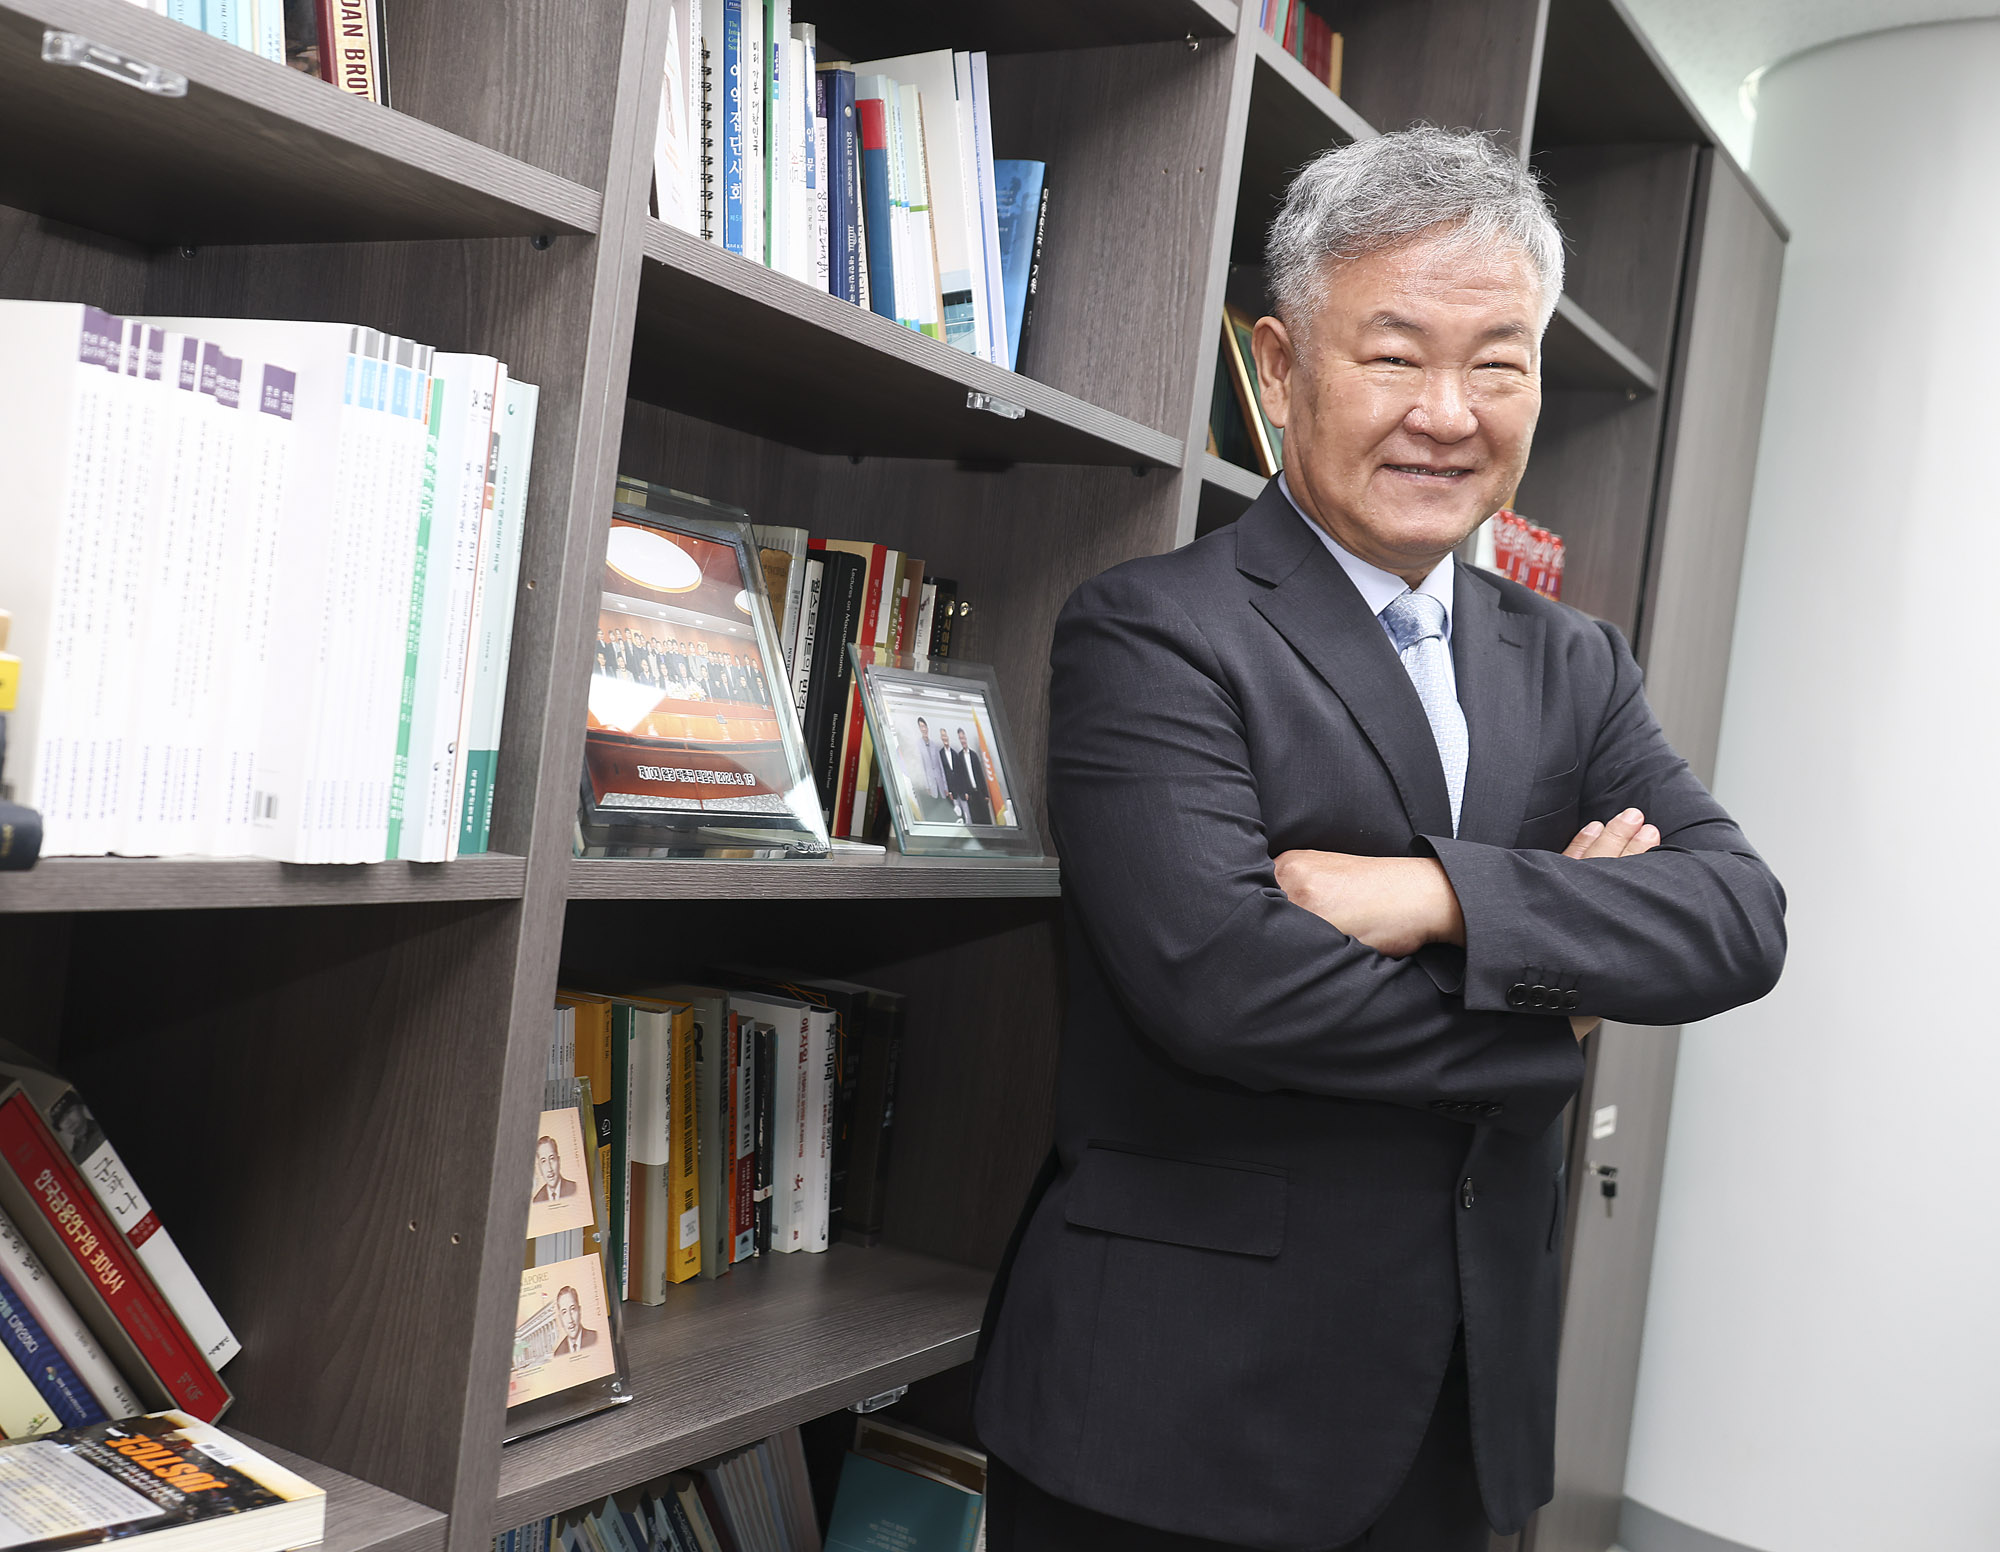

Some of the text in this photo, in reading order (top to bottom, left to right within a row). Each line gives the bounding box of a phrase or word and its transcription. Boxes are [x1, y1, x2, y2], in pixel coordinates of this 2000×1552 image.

[845, 131, 854, 156] 2012
[796, 577, 820, 710] 월스트리트의 반격
[837, 568, 858, 678] Lectures on Macroeconomics
[830, 713, 838, 748] Blanchard
[684, 1031, 692, 1043] THE
[684, 1045, 692, 1071] BASICS
[824, 1023, 836, 1080] 부의 미래
[742, 1029, 753, 1149] WHY NATIONS FAIL
[684, 1114, 692, 1130] AND
[93, 1155, 140, 1216] 군과 나
[33, 1168, 124, 1295] 한국금융연구원 30년사
[520, 1271, 549, 1287] APORE
[105, 1434, 229, 1494] JUSTICE
